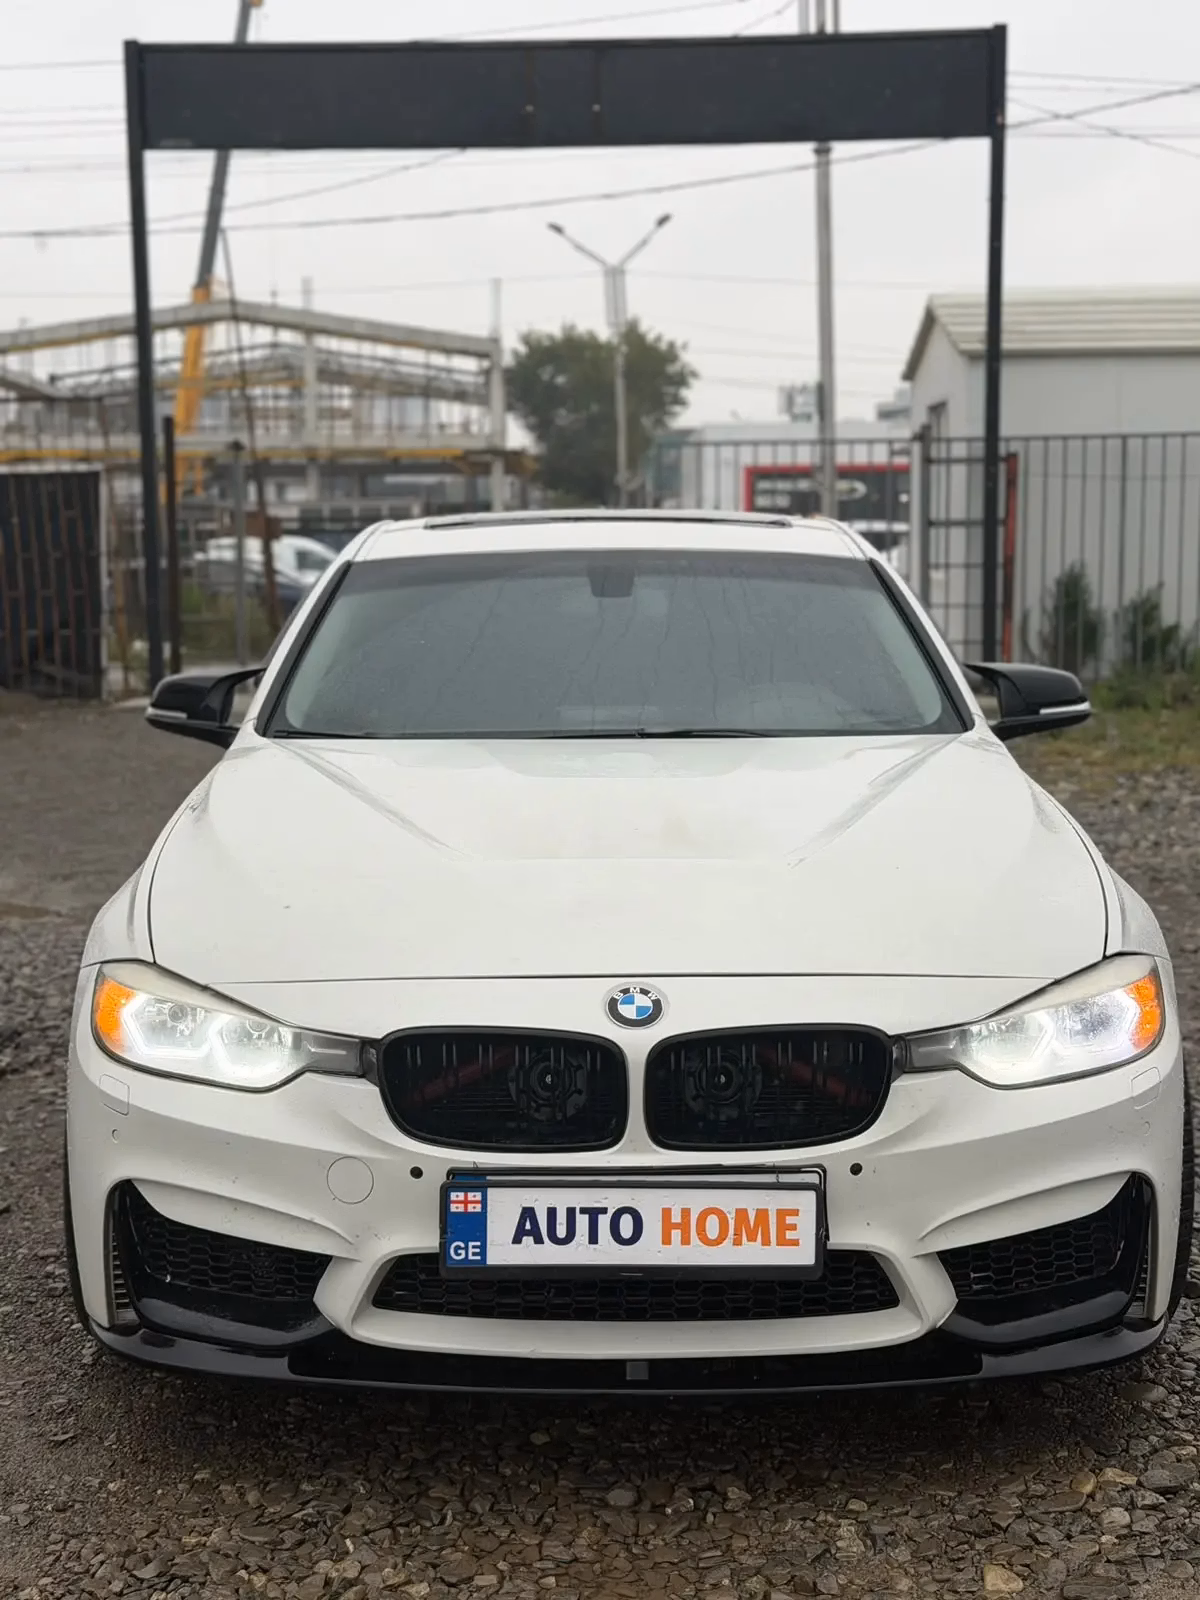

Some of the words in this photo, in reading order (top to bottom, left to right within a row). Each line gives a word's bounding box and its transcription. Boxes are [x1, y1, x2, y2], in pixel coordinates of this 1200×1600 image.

[612, 987, 658, 1000] BMW
[511, 1206, 644, 1247] AUTO
[661, 1207, 801, 1248] HOME
[449, 1241, 482, 1260] GE
